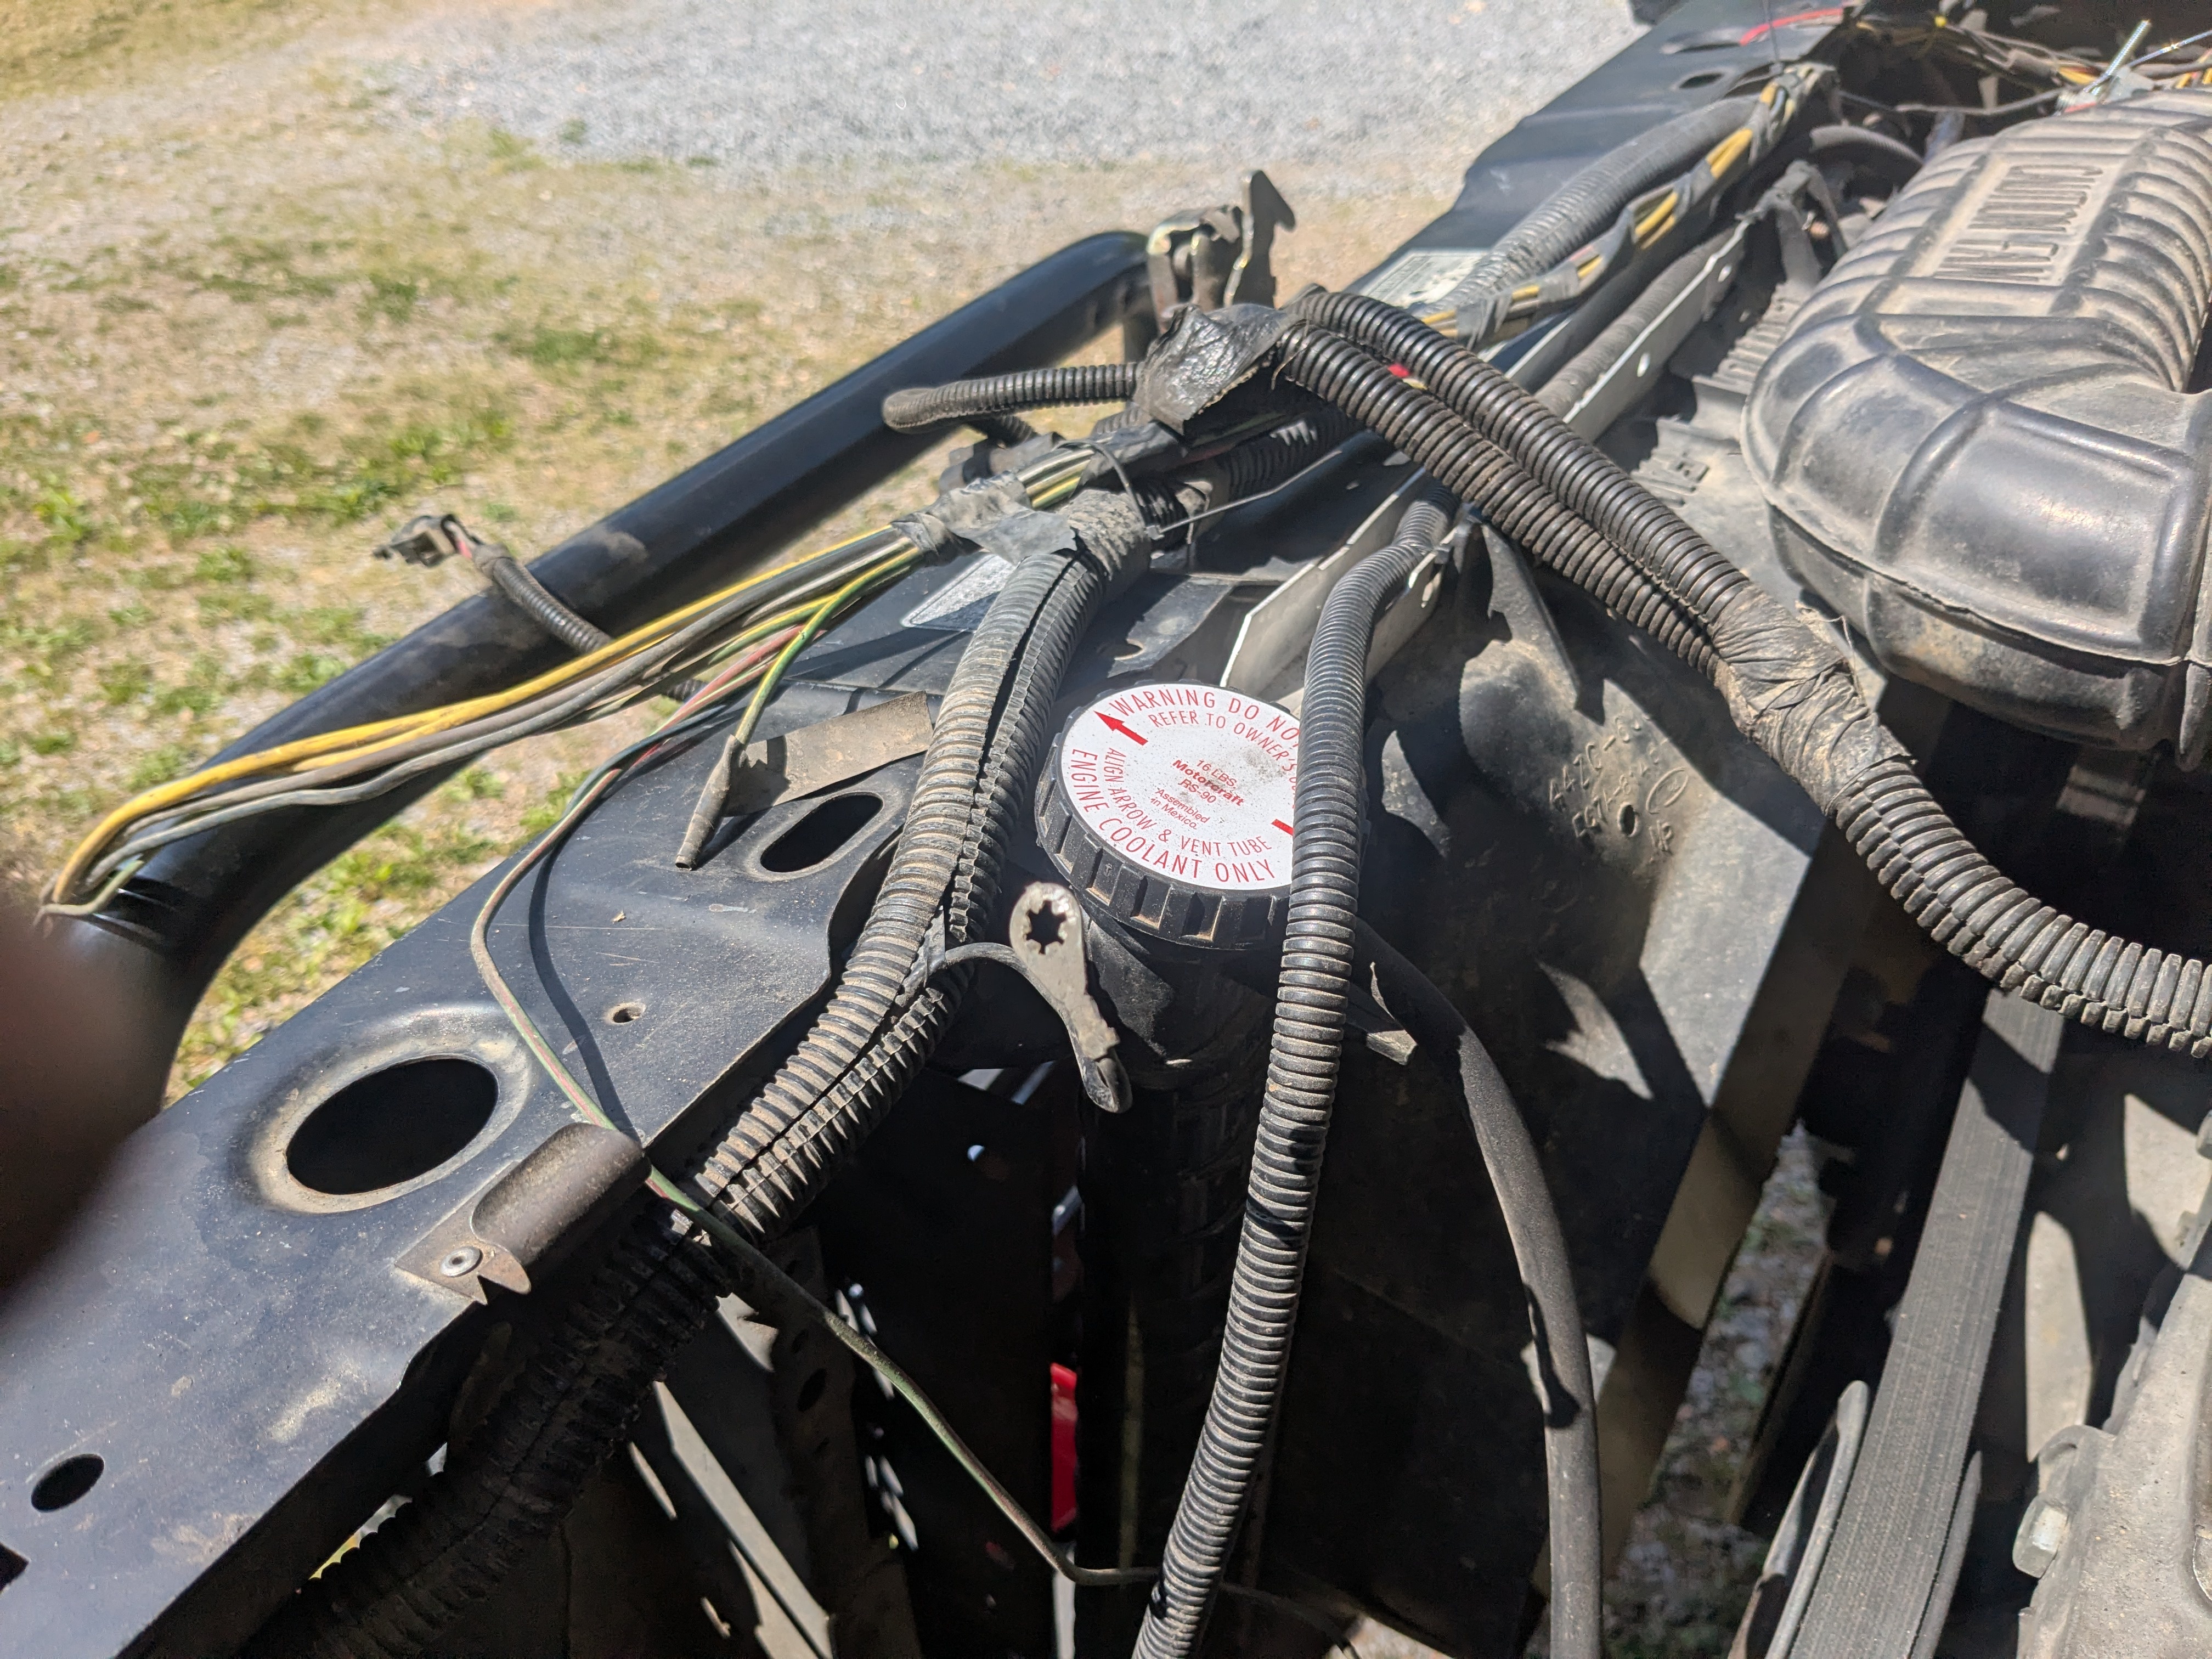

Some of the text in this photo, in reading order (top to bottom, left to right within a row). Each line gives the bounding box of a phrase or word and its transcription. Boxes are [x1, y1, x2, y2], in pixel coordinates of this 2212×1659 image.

[1109, 689, 1300, 747] WARNING DO NO
[1148, 710, 1198, 727] REFER
[1206, 713, 1226, 729] TO
[1172, 759, 1245, 806] Motorcraft
[1181, 778, 1217, 804] RS-90
[1196, 759, 1238, 790] 16 LBS.
[1070, 749, 1276, 883] ENGINE COOLANT ONLY
[1103, 748, 1272, 857] ALIGN ARROW & VENT TUBE
[1150, 798, 1163, 806] in
[1155, 788, 1210, 823] Assembled
